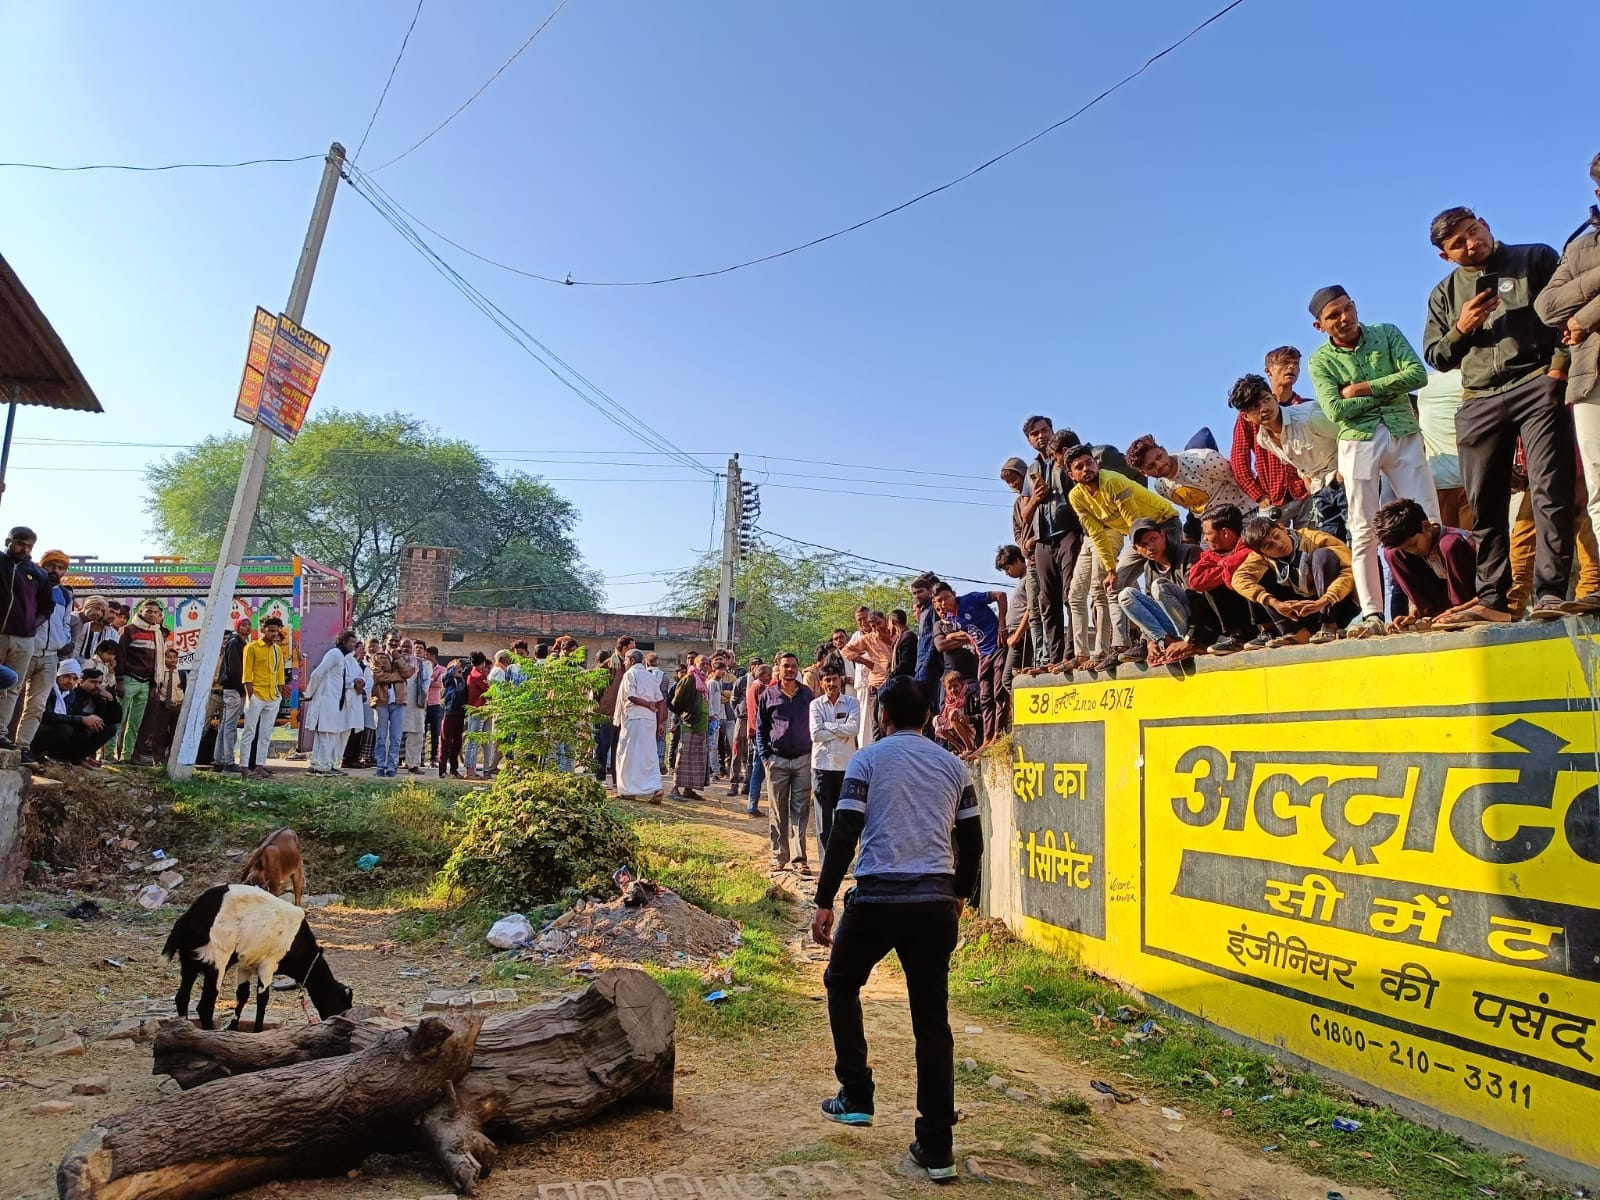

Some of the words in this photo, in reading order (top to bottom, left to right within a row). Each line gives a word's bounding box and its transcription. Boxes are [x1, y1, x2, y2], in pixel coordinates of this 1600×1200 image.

[281, 316, 328, 357] MOCHAN
[1029, 693, 1050, 714] 38
[1012, 745, 1045, 803] देश
[1053, 763, 1088, 801] का
[1226, 923, 1358, 990] इंजीनियर
[1380, 962, 1440, 1010] की
[1471, 992, 1597, 1063] पसंद
